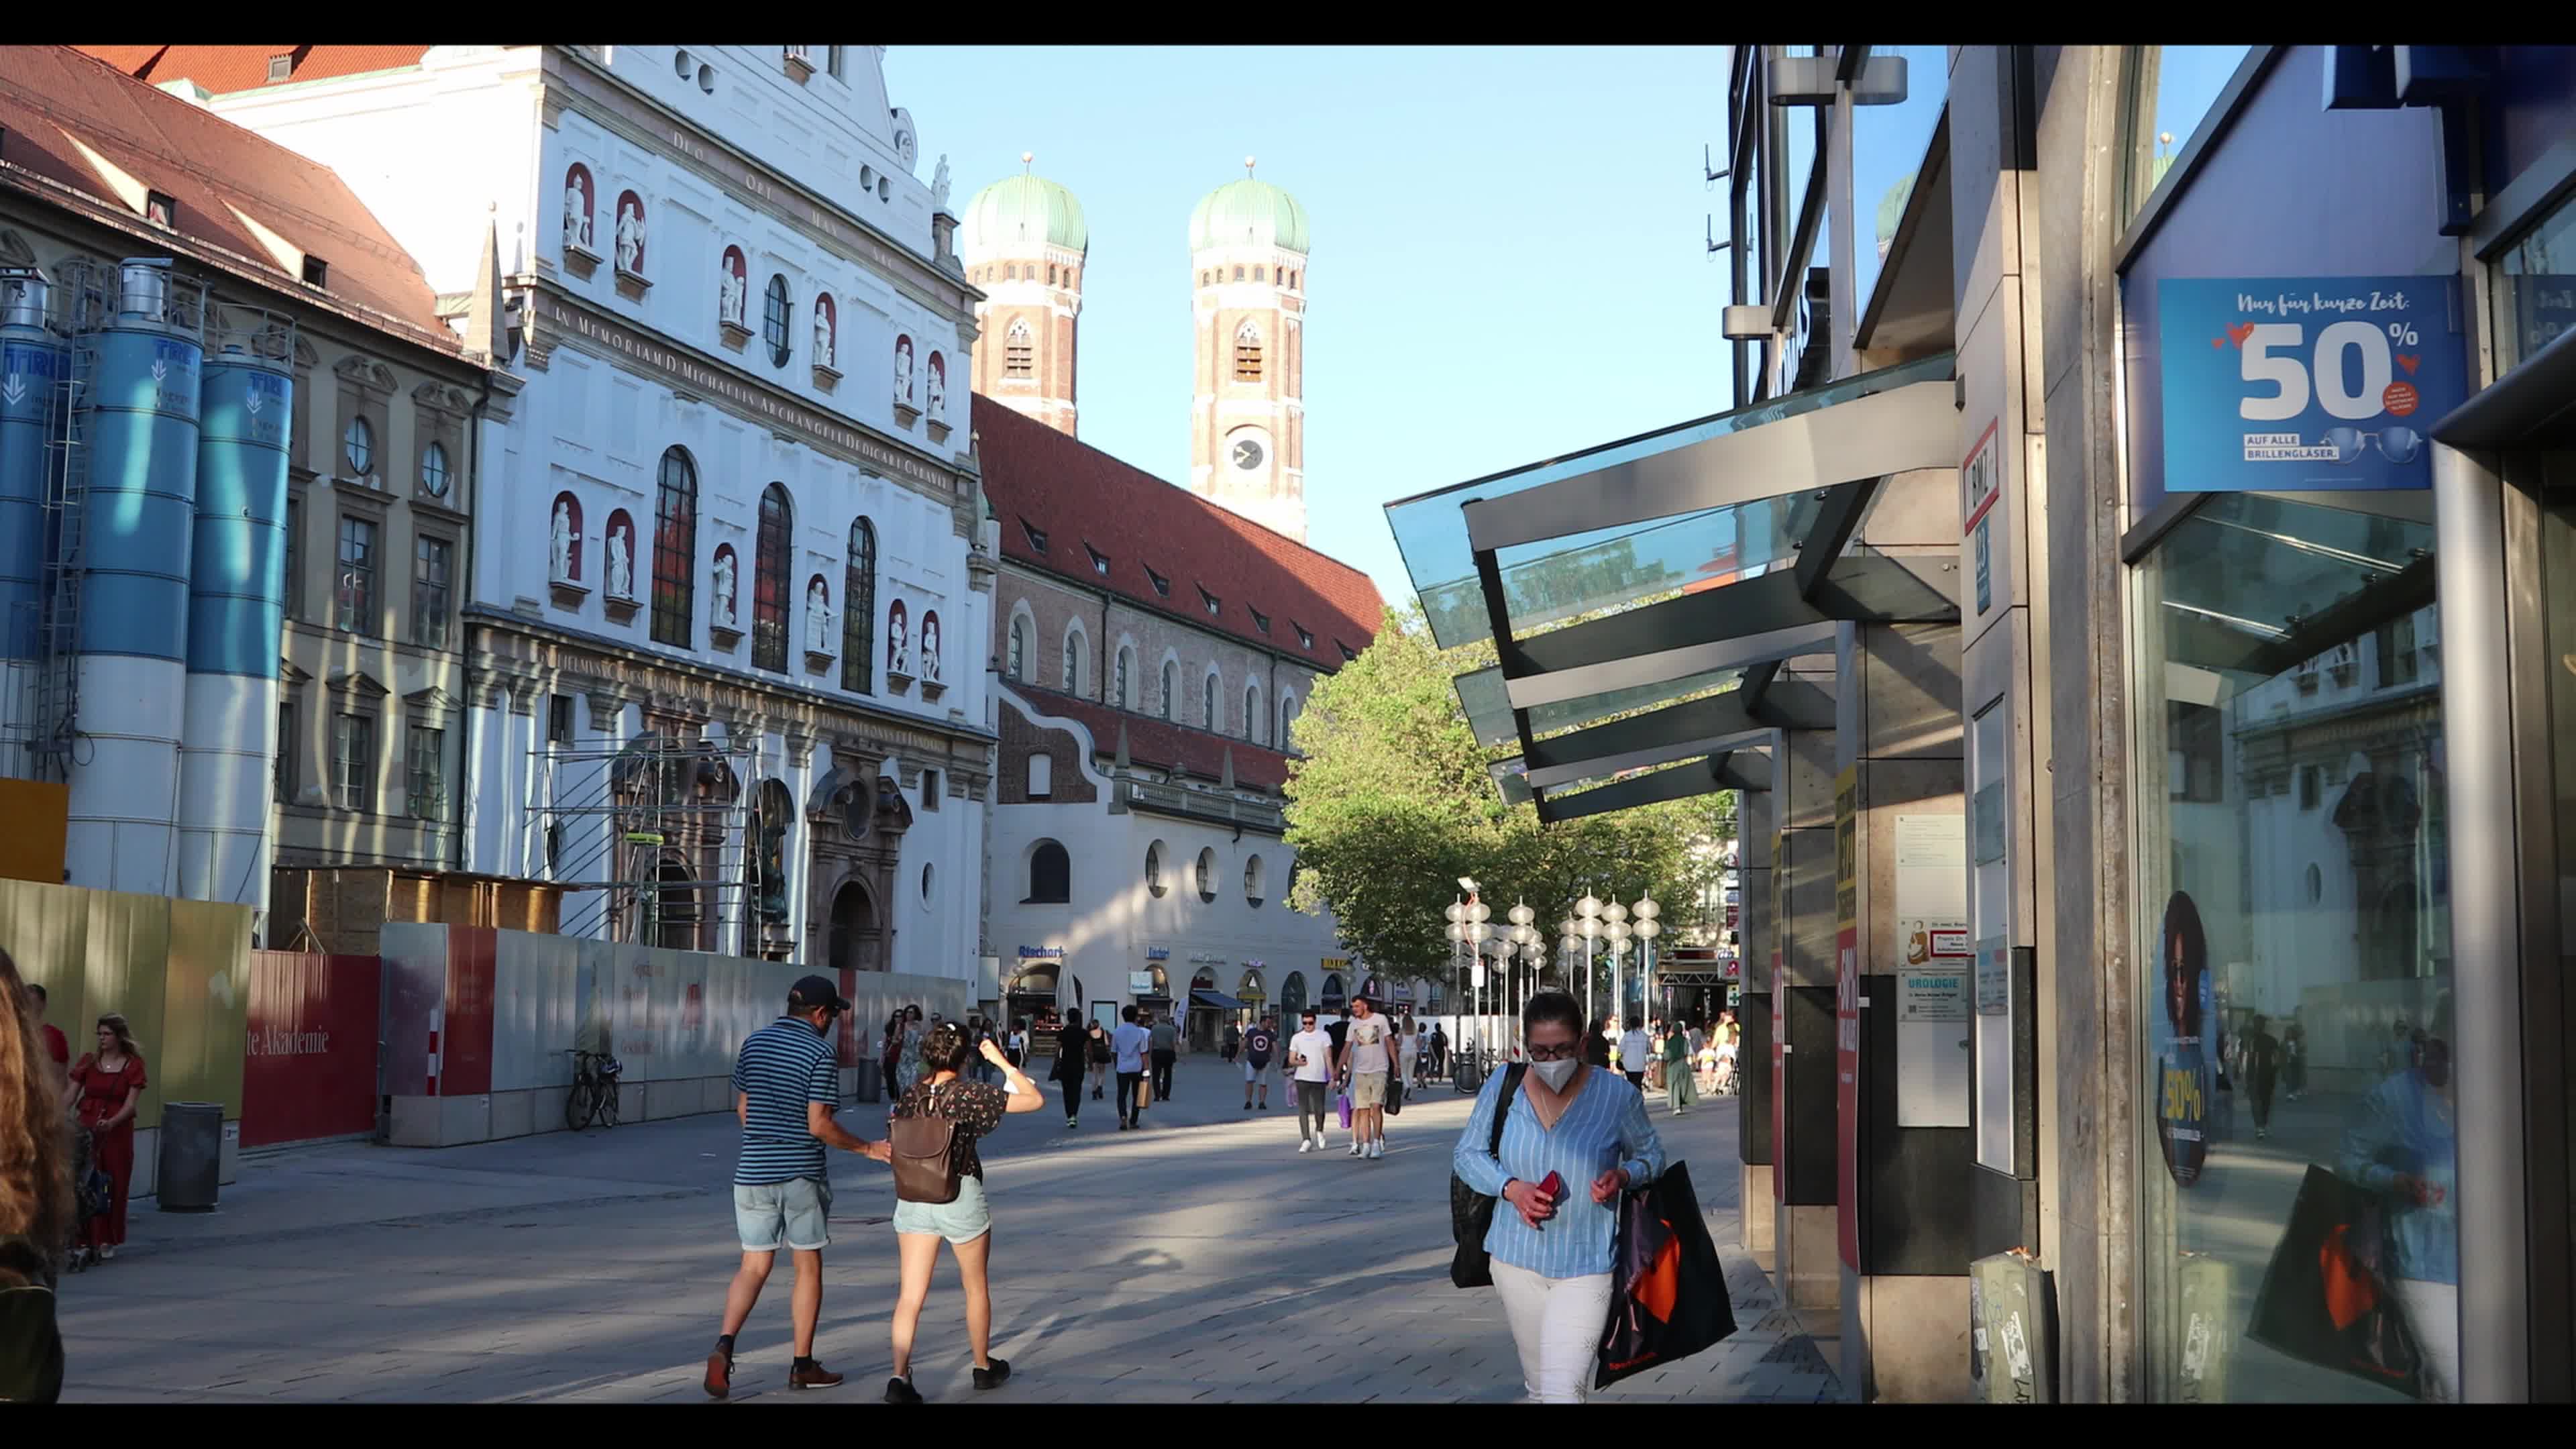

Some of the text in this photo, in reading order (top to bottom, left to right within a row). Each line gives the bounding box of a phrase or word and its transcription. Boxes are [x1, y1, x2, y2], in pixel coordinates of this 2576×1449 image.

[2237, 292, 2275, 315] Nur
[2278, 292, 2312, 317] für
[2314, 292, 2367, 313] kurze
[2239, 321, 2419, 422] 50%
[2247, 435, 2298, 445] AUF ALLE
[1909, 978, 1960, 989] UROLOGIE
[260, 1024, 329, 1055] Akademie
